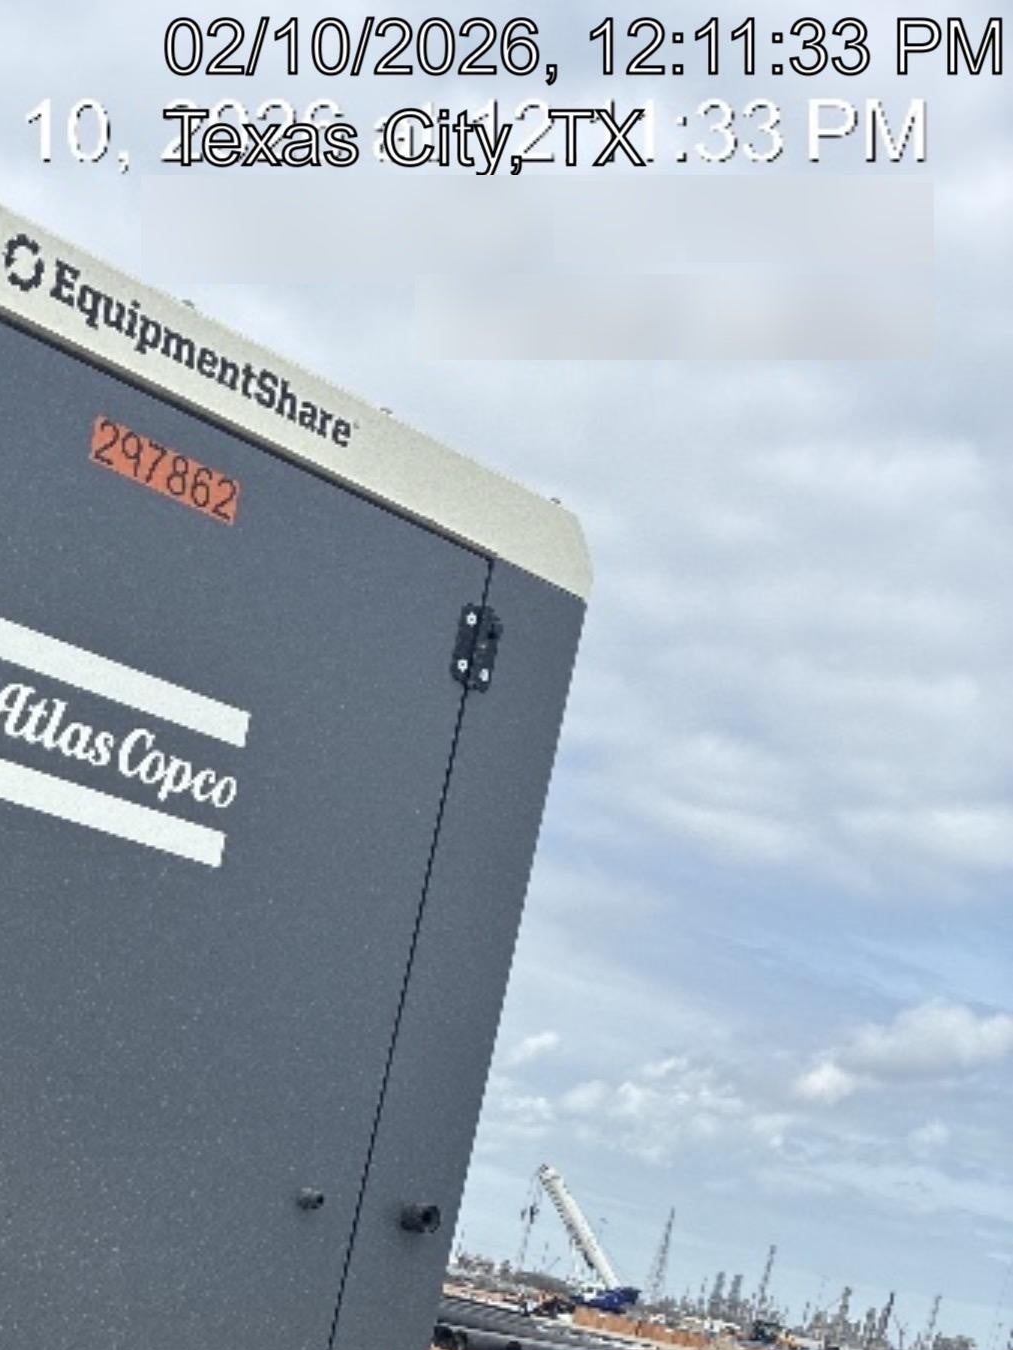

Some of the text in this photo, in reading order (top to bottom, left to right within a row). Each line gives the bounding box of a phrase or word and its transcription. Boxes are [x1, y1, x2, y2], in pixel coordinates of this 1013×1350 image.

[50, 258, 352, 448] EquipmentShare
[92, 419, 239, 522] 297862
[118, 727, 238, 809] Copco
